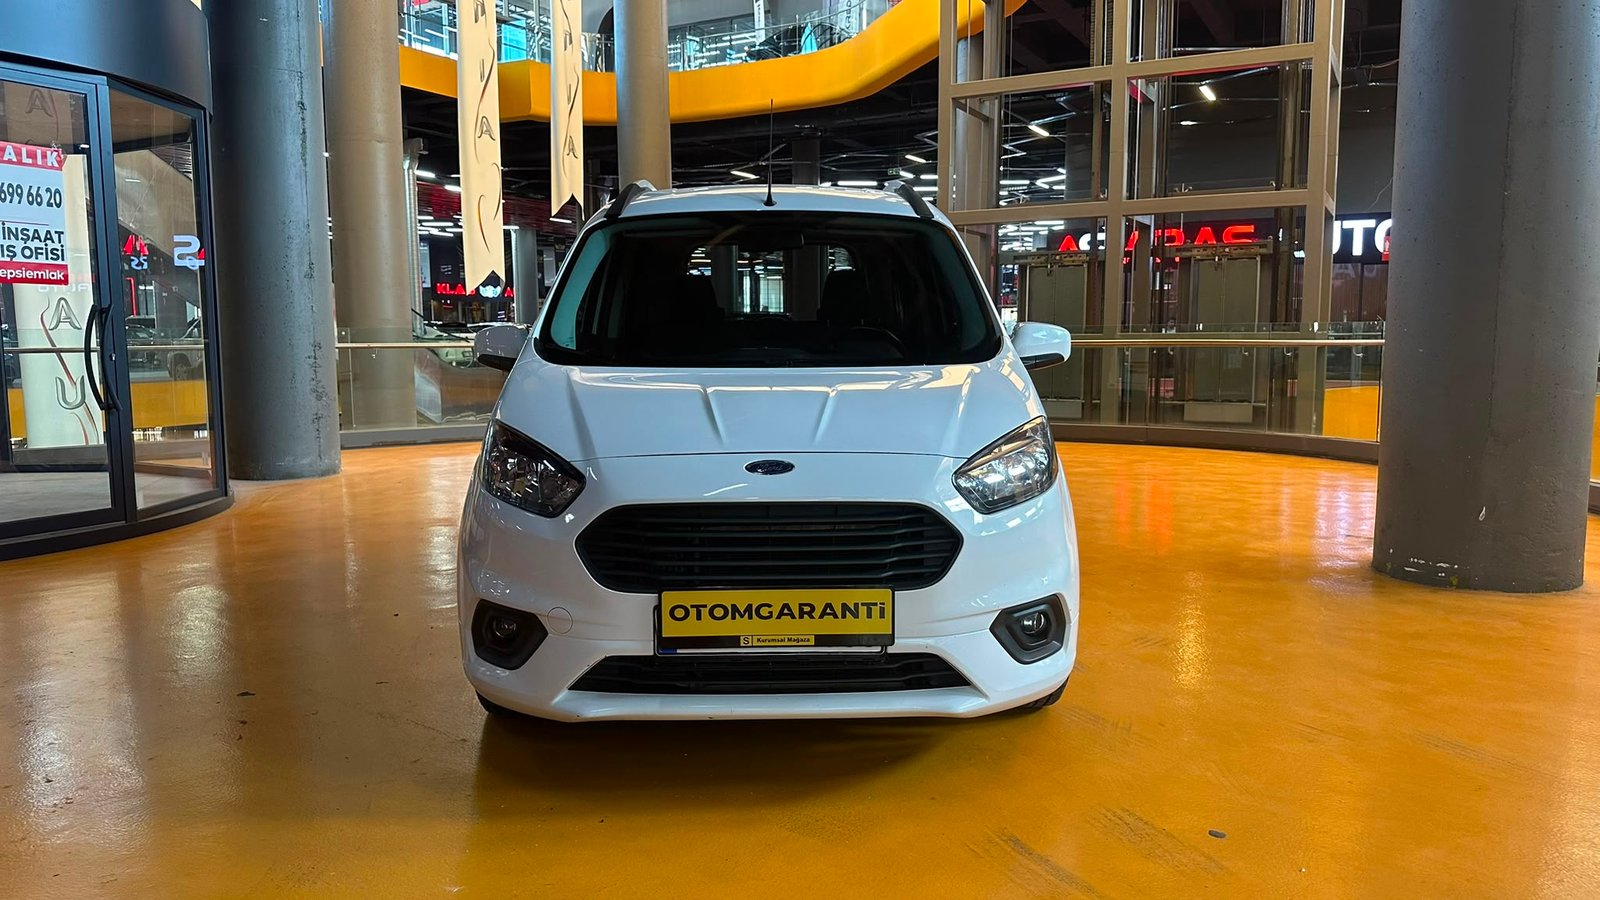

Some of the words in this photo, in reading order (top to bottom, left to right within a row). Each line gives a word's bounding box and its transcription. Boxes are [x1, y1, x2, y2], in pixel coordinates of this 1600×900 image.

[3, 144, 60, 167] ALIK
[0, 182, 24, 205] 699
[26, 185, 43, 207] 66
[45, 187, 62, 209] 20
[1, 221, 64, 245] İNŞAAT
[20, 243, 65, 262] OFİSİ
[756, 636, 786, 644] Kurumsal
[787, 636, 811, 644] Mağaza
